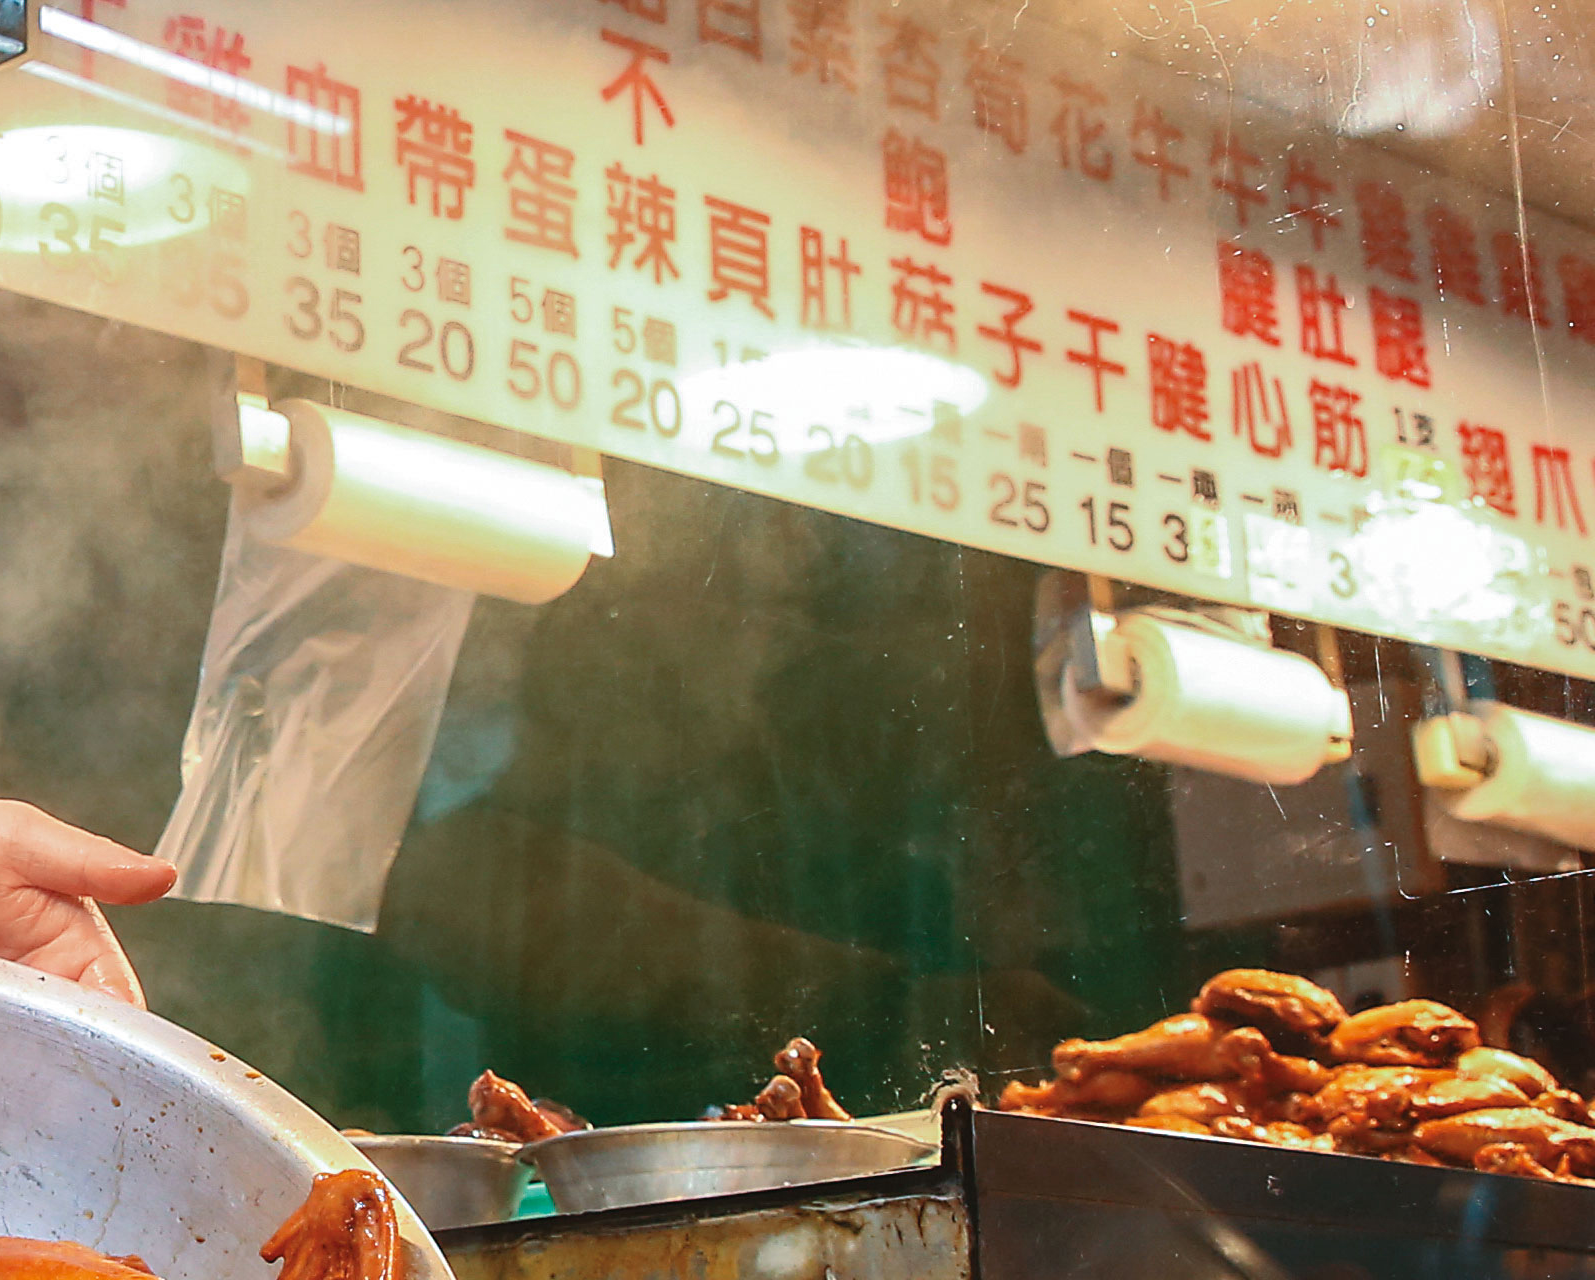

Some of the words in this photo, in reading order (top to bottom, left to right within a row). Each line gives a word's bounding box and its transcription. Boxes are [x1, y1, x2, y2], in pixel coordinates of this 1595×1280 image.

[285, 209, 361, 278] 3個
[401, 244, 471, 309] 3個
[283, 275, 366, 353] 35
[509, 274, 577, 339] 5個
[397, 308, 476, 383] 20
[506, 337, 582, 412] 50
[612, 368, 682, 440] 20
[711, 400, 780, 467] 25
[804, 424, 876, 492] 20
[899, 445, 959, 513] 15
[989, 474, 1050, 534] 25
[1078, 495, 1134, 552] 15
